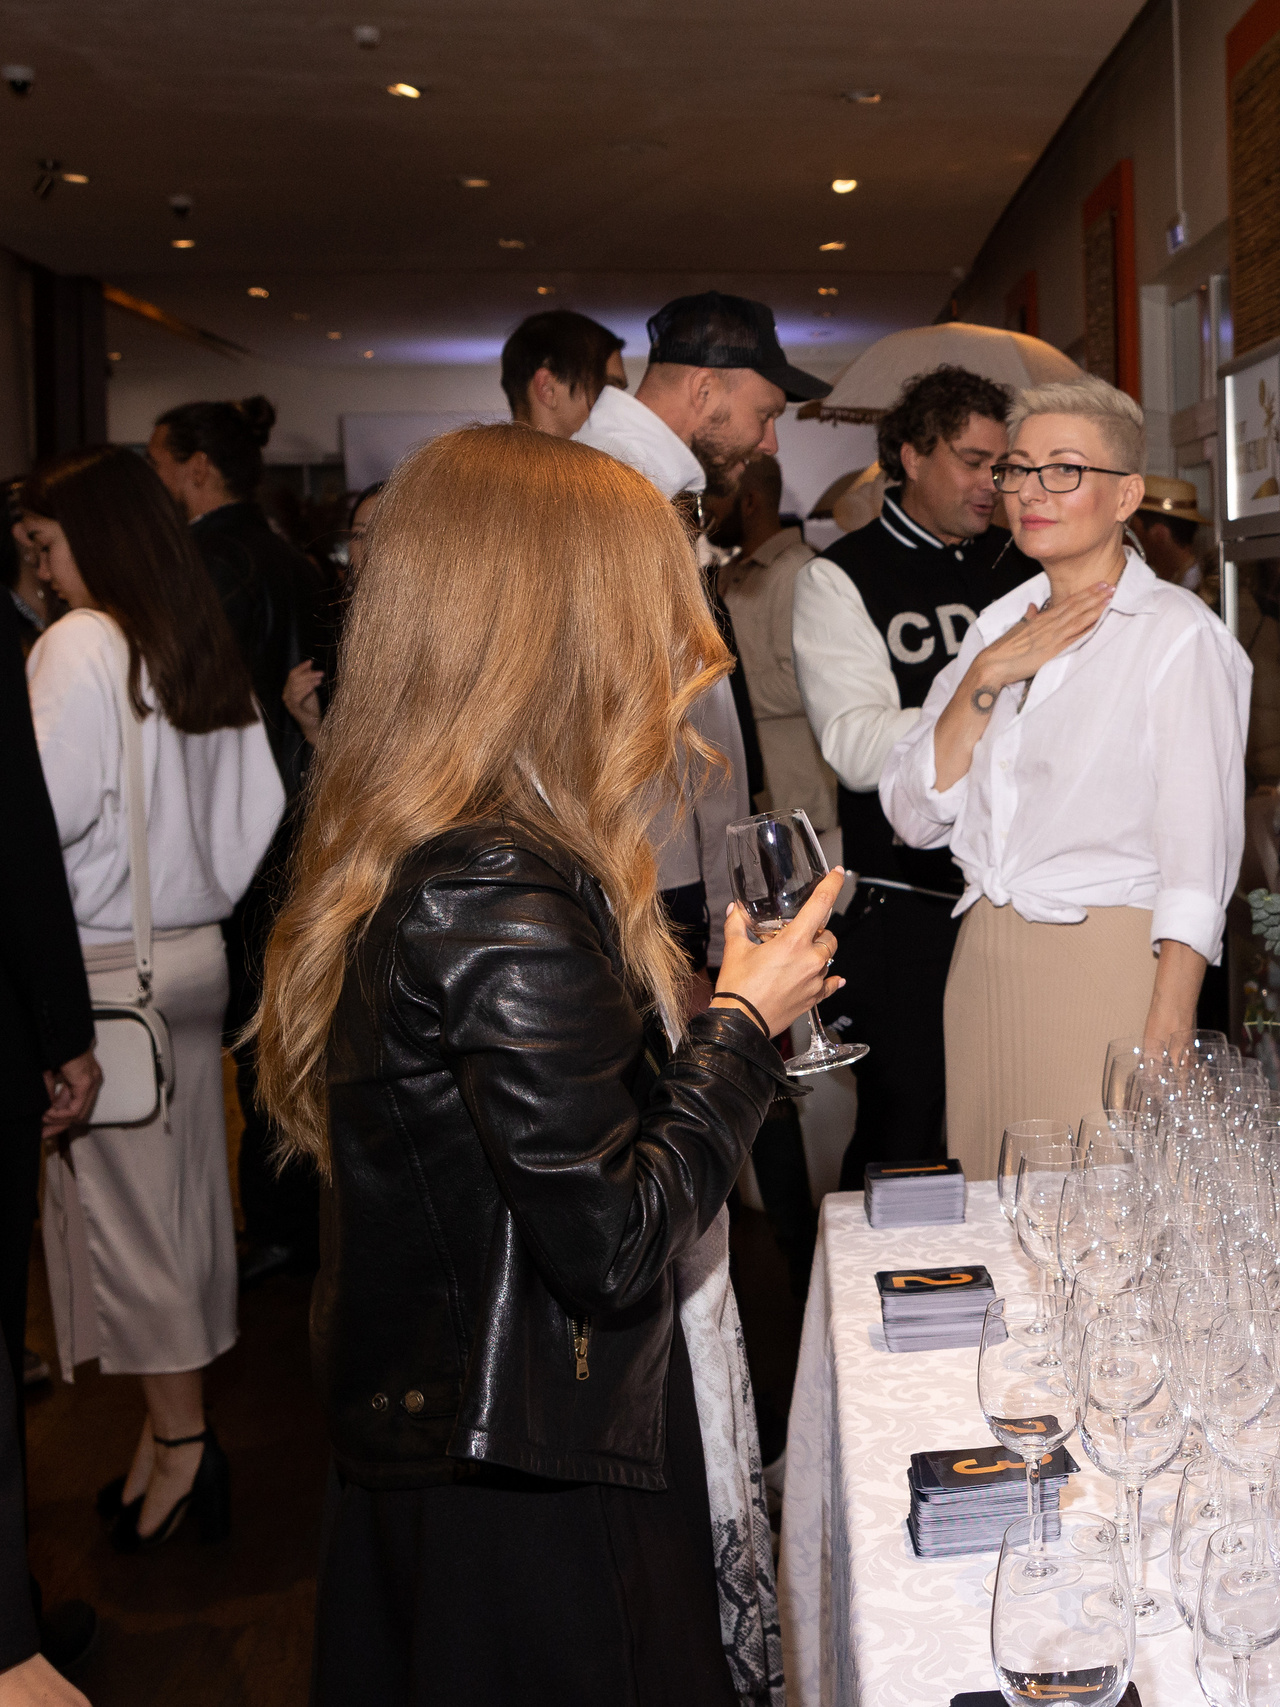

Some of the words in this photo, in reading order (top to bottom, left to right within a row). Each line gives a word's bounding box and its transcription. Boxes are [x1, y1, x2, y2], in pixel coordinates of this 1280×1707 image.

[887, 603, 979, 664] CD
[892, 1273, 974, 1288] 2
[952, 1453, 1053, 1475] 3
